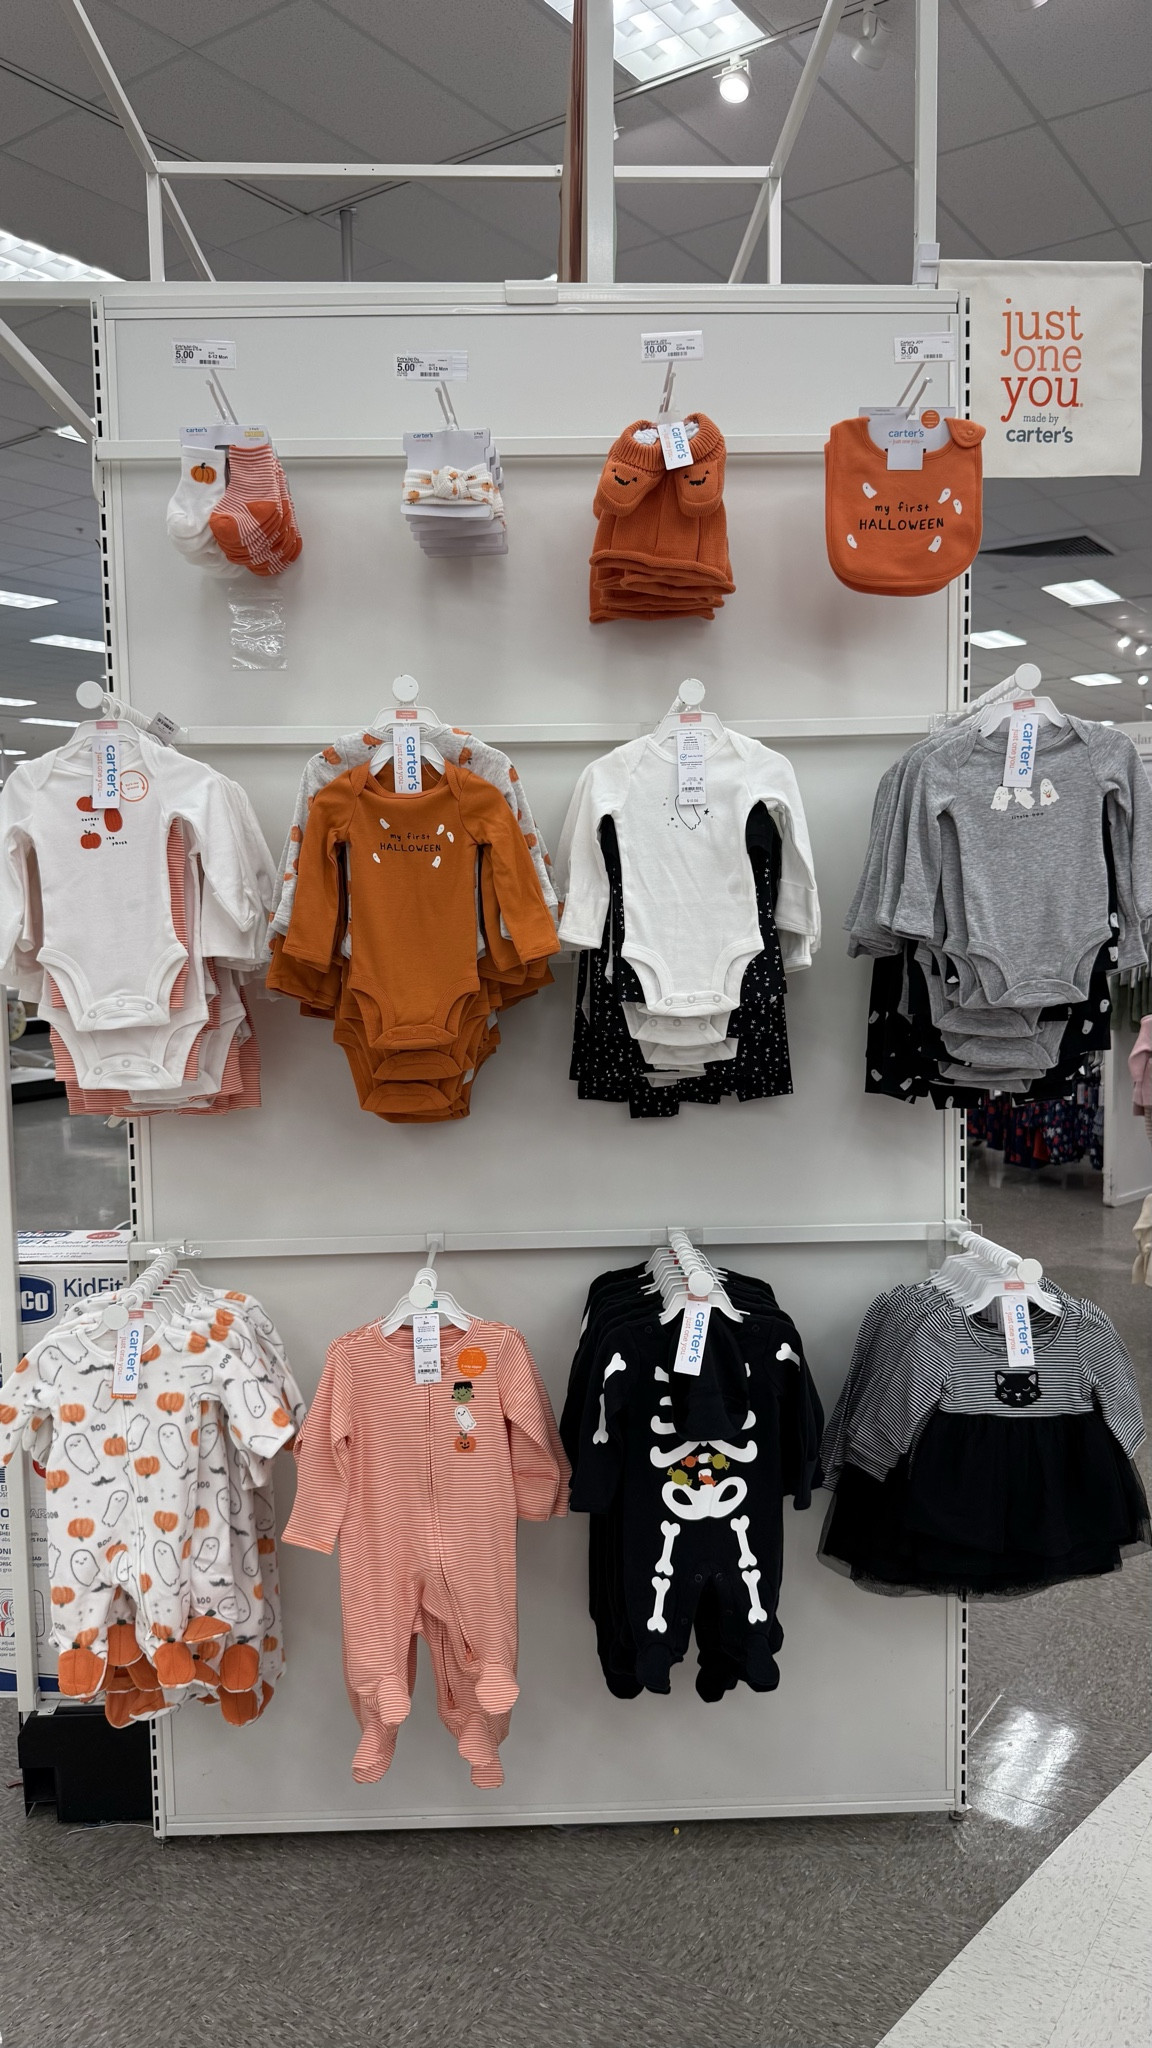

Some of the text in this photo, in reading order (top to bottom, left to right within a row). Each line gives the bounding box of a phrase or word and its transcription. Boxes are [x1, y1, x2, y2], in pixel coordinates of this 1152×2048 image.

[1000, 298, 1084, 356] just
[175, 350, 194, 359] 5.00
[645, 344, 668, 354] 10.00
[901, 346, 919, 355] 5.00
[1013, 345, 1082, 373] one
[397, 363, 415, 372] 5.00
[1000, 376, 1082, 422] you
[1023, 413, 1059, 426] made by
[888, 428, 924, 438] carter's
[1006, 426, 1073, 443] carter's
[671, 427, 689, 459] carter's
[875, 502, 929, 516] my first
[859, 518, 944, 531] HALLOWEEN
[1018, 723, 1033, 776] carter's
[406, 736, 420, 790] carter's
[1008, 755, 1016, 769] you
[106, 745, 119, 798] carter's
[396, 771, 404, 785] you
[390, 832, 430, 842] my first
[380, 842, 441, 852] HALLOWEEN
[63, 1277, 123, 1298] KidFit
[1015, 1304, 1032, 1355] carter's
[688, 1311, 705, 1363] carter's
[1008, 1336, 1016, 1350] you
[125, 1329, 139, 1382] carter's
[219, 1353, 232, 1369] BOO
[91, 1423, 106, 1432] BOO
